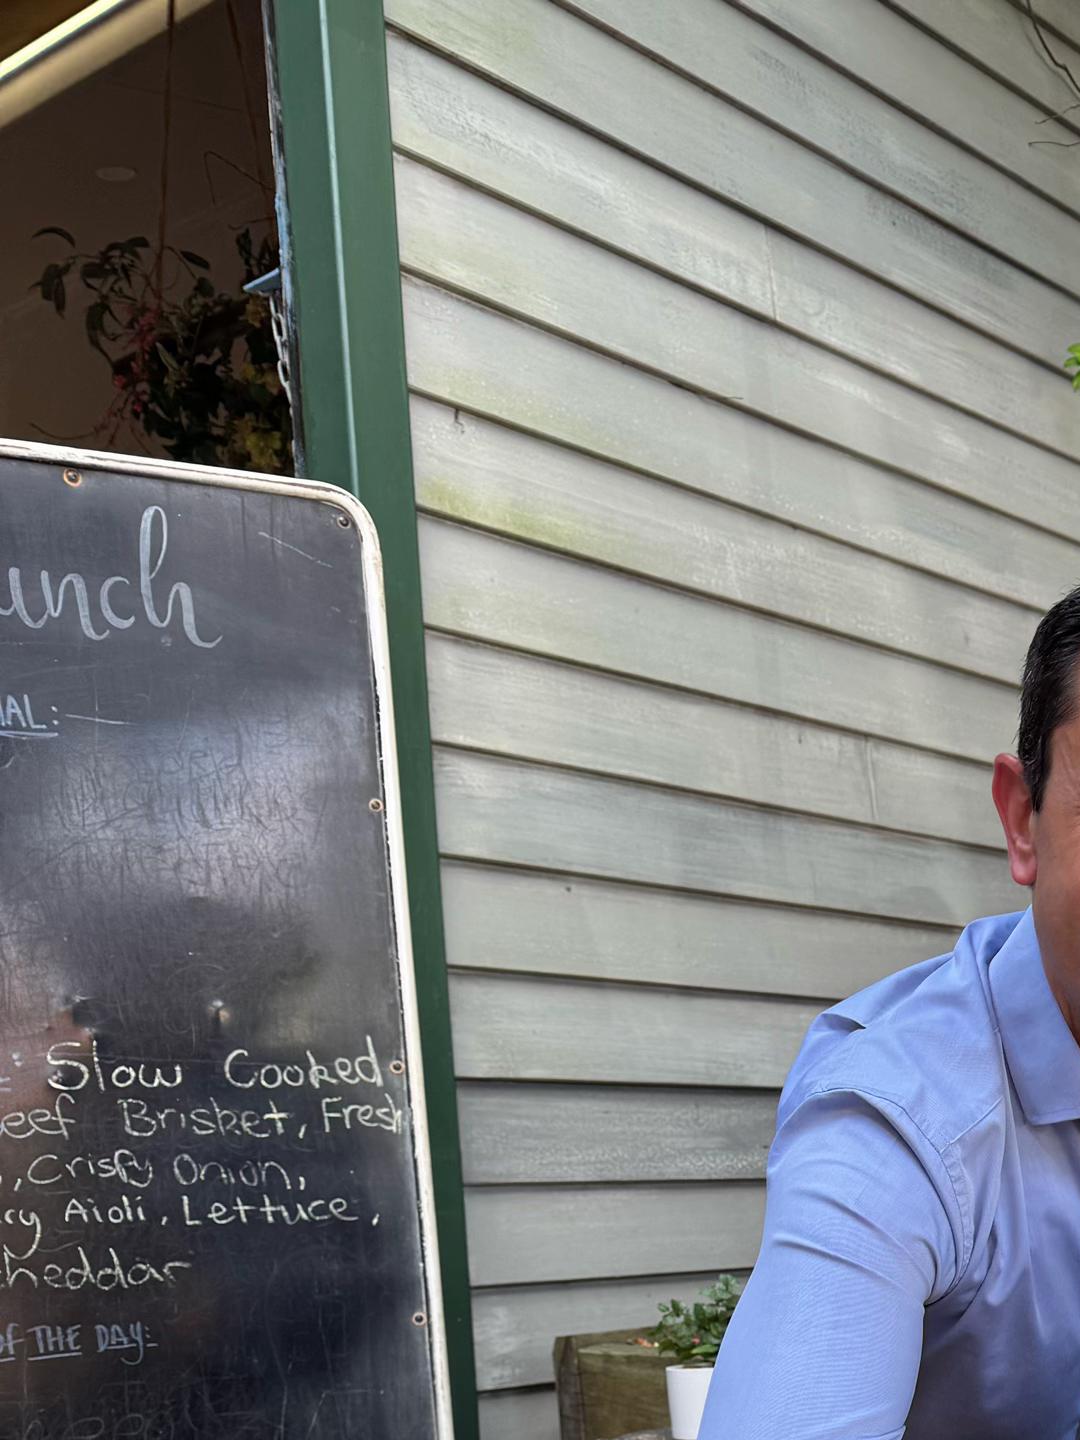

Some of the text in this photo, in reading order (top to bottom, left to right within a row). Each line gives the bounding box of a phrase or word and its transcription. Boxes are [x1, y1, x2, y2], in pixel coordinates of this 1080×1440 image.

[0, 505, 223, 648] unch
[46, 1035, 384, 1093] Slow Cooked
[0, 1093, 402, 1140] eef Brisket, Fresh
[173, 1153, 305, 1190] Onion,
[64, 1195, 168, 1226] Aioli,
[182, 1195, 380, 1227] Lettuce,
[0, 1247, 192, 1291] heddar
[27, 1324, 82, 1354] THE
